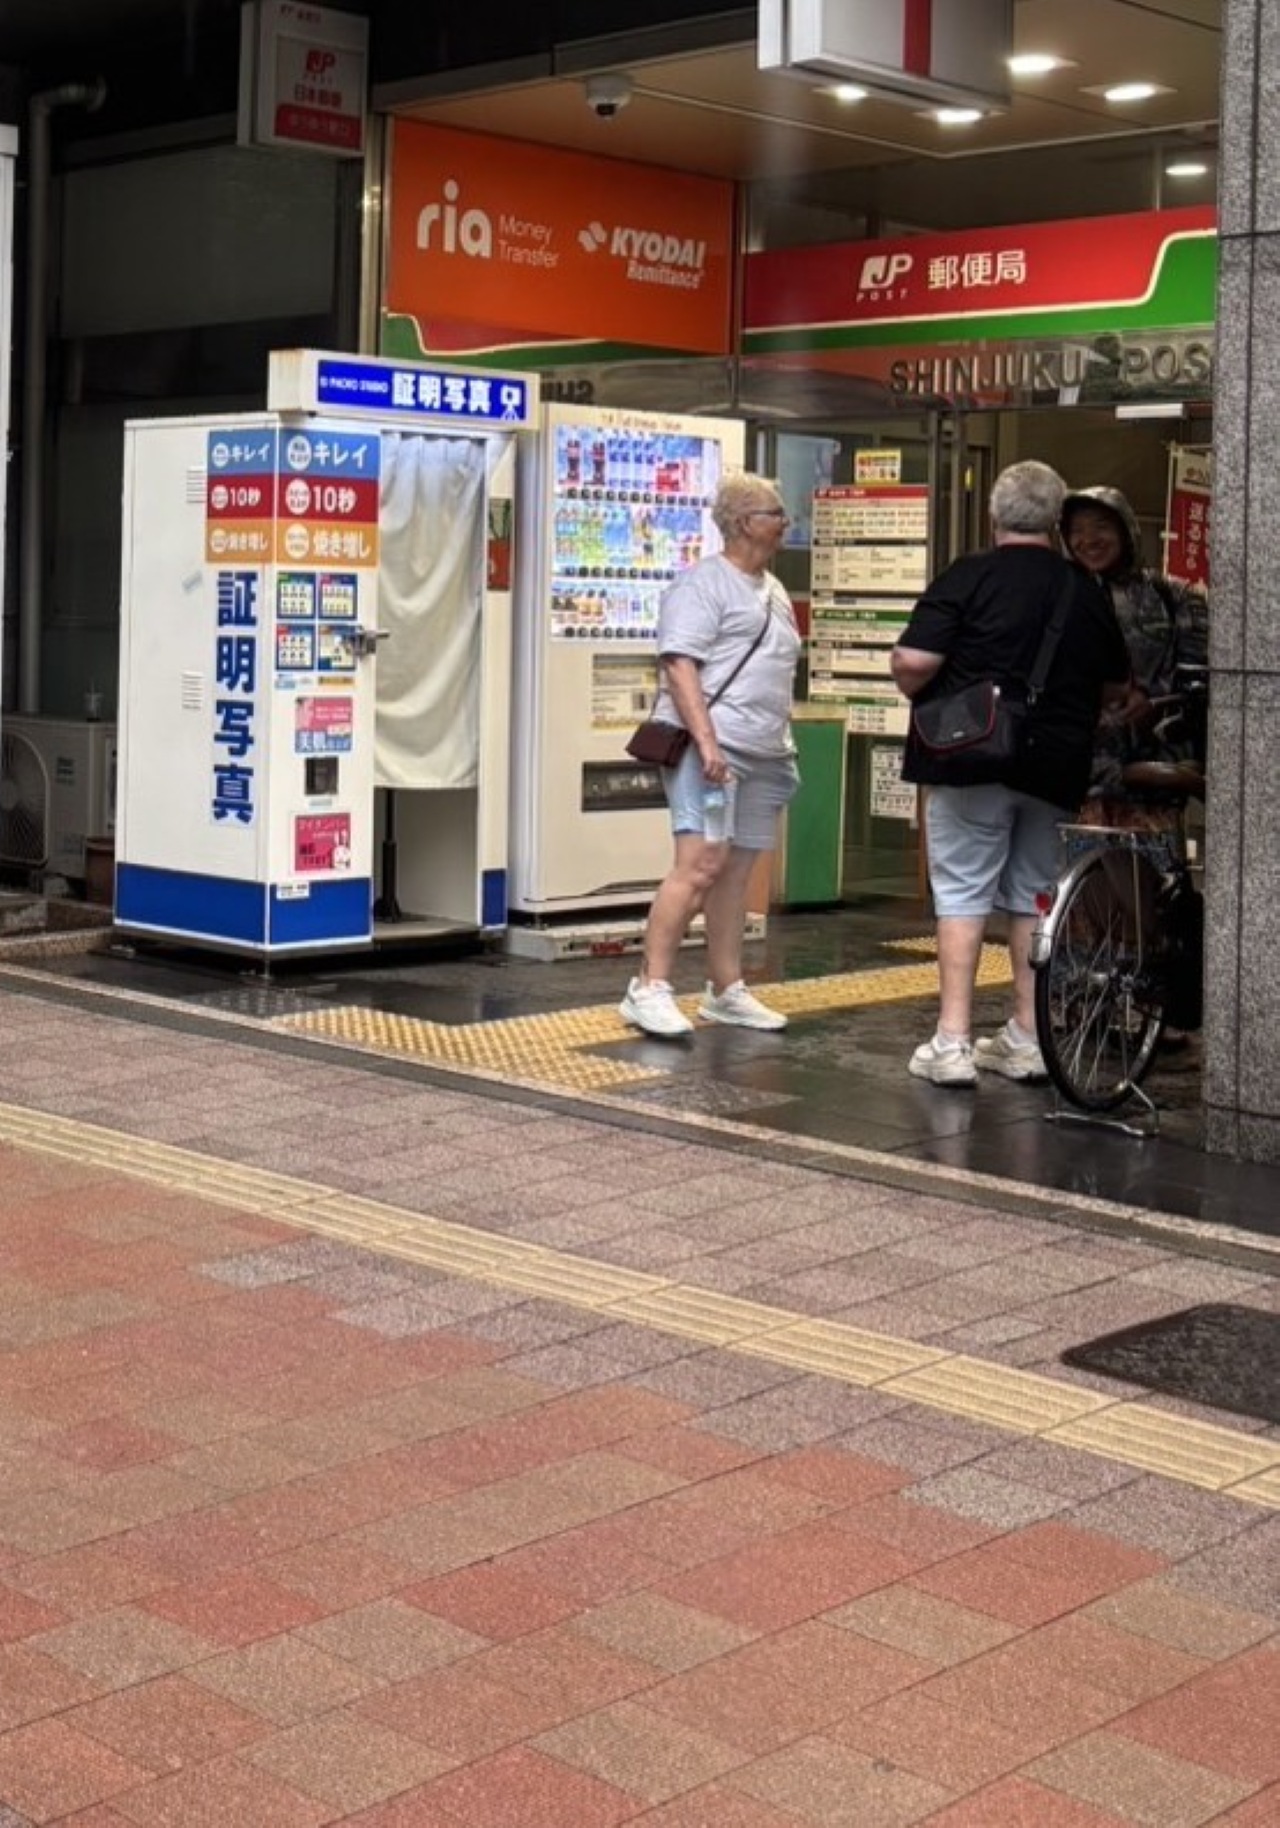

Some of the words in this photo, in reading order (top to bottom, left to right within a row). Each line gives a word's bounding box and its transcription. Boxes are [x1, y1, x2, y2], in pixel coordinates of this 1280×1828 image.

[417, 179, 492, 258] ria
[499, 214, 552, 245] Money
[499, 239, 559, 268] Transfer
[611, 226, 706, 268] KYODAI
[859, 253, 913, 289] JP
[928, 250, 1027, 290] 郵便局
[856, 288, 909, 302] POST
[890, 350, 1089, 396] SHINJUKU
[1121, 343, 1213, 385] POS
[392, 371, 493, 414] 証明写真
[231, 443, 270, 462] キレイ
[313, 440, 369, 470] キレイ
[230, 487, 262, 507] 10秒
[313, 486, 358, 514] 10秒
[212, 572, 258, 825] 証明写真
